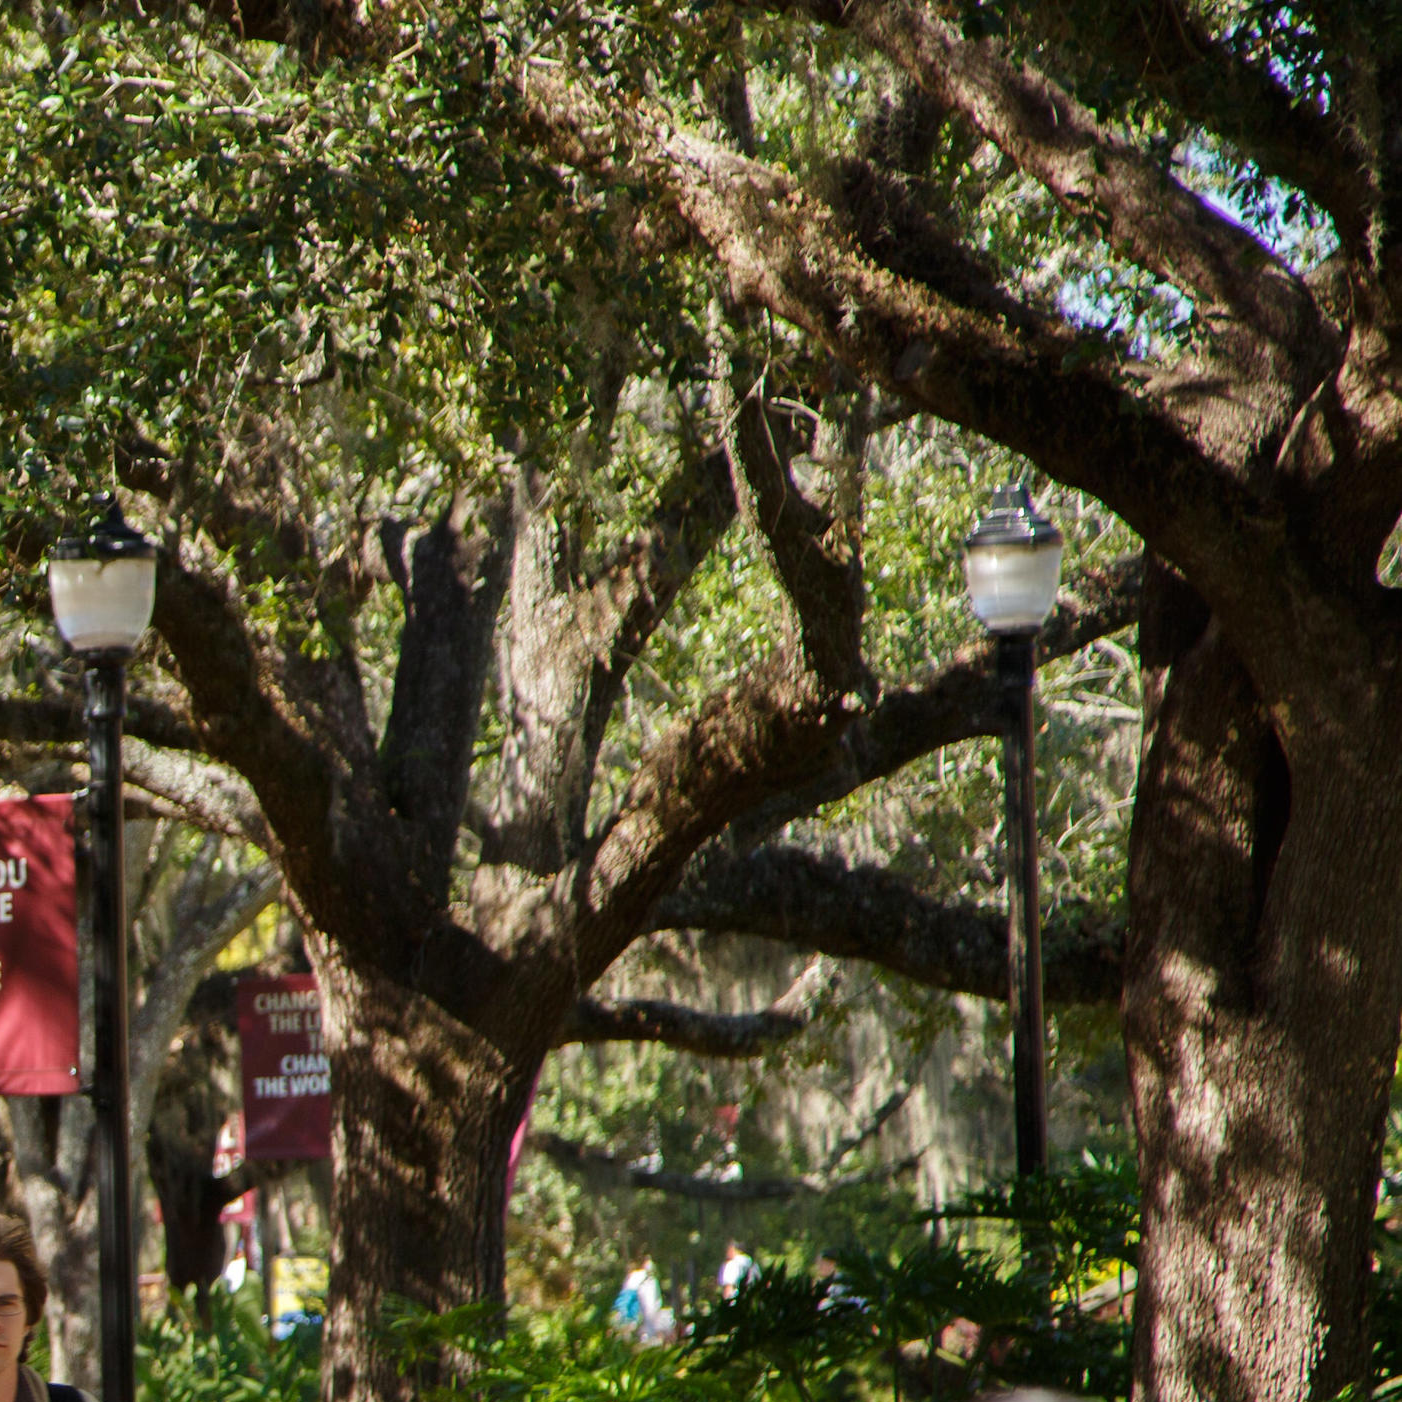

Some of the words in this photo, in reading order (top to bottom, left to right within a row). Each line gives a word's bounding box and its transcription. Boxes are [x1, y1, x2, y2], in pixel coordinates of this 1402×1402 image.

[255, 991, 318, 1012] CHANG
[269, 1013, 300, 1033] THE
[281, 1052, 330, 1074] CHAN
[255, 1076, 287, 1098] THE
[290, 1073, 332, 1097] WOR
